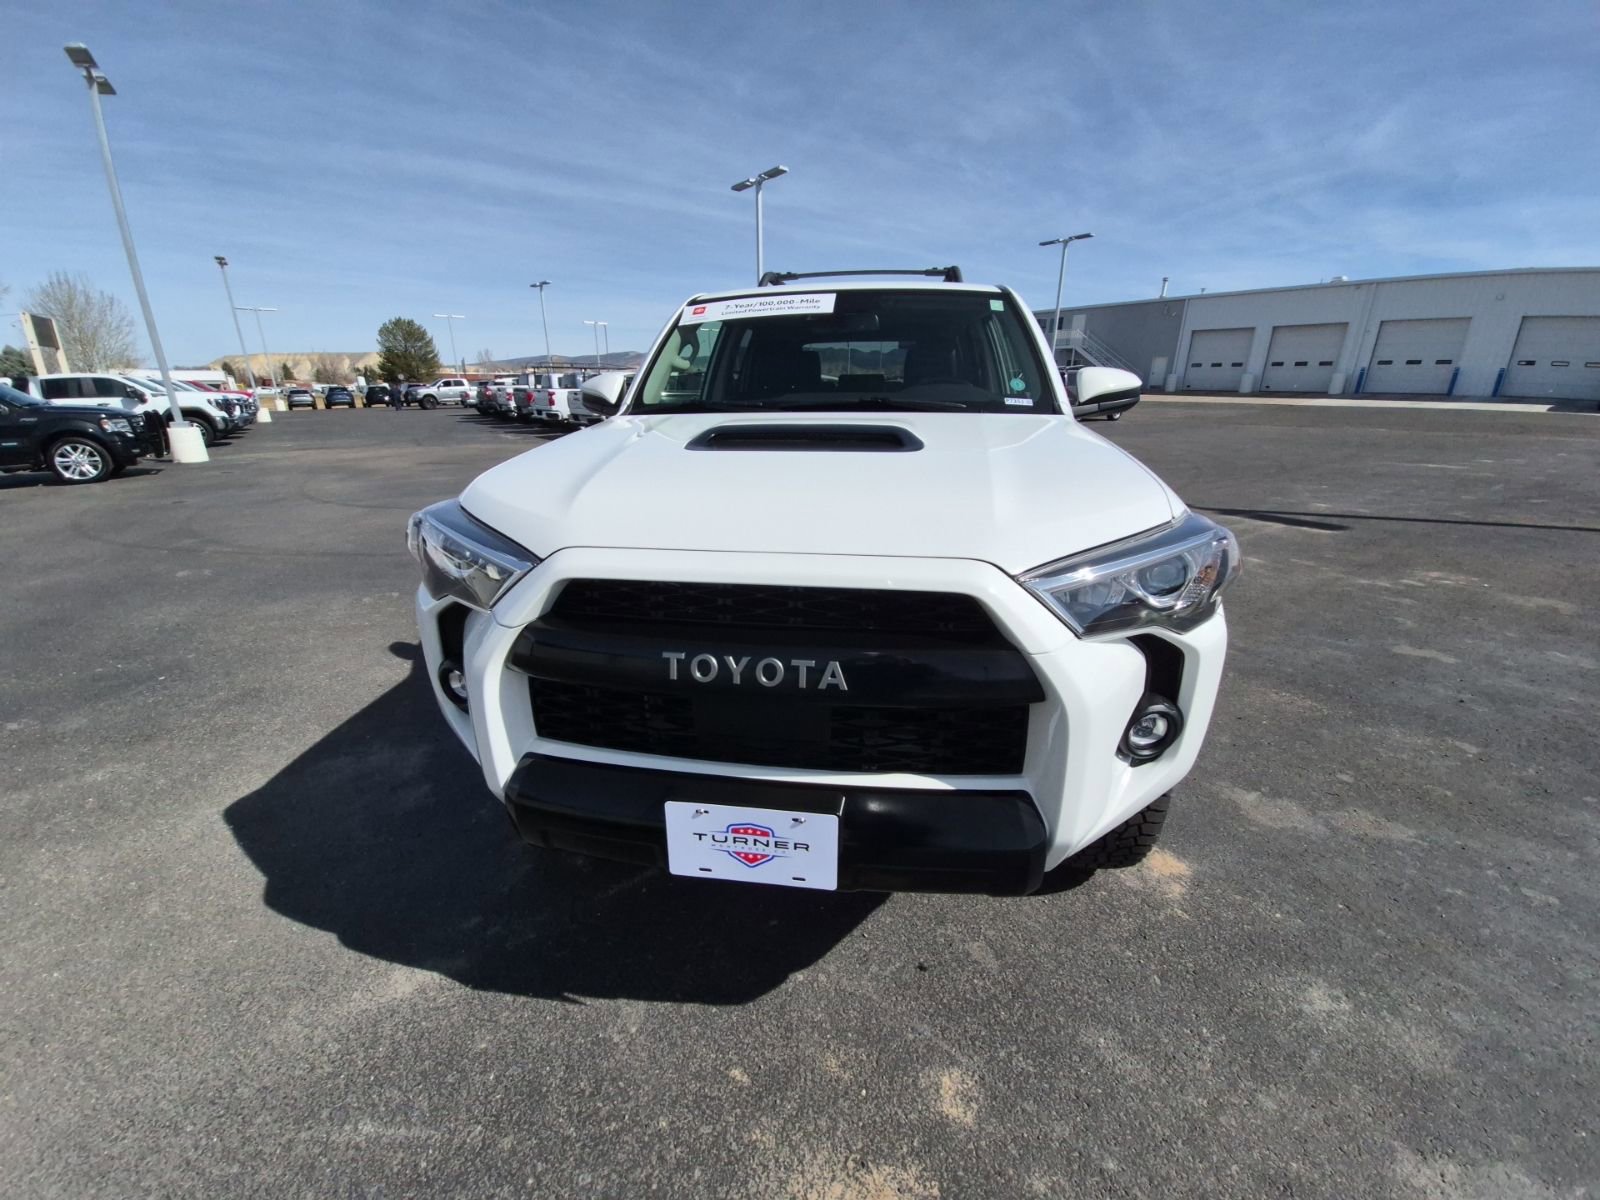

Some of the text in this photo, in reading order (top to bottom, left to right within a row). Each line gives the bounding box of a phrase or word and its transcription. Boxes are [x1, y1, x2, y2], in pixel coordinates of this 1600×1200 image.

[721, 308, 748, 316] Limited
[662, 652, 848, 690] TOYOTA
[693, 832, 810, 852] TURNER
